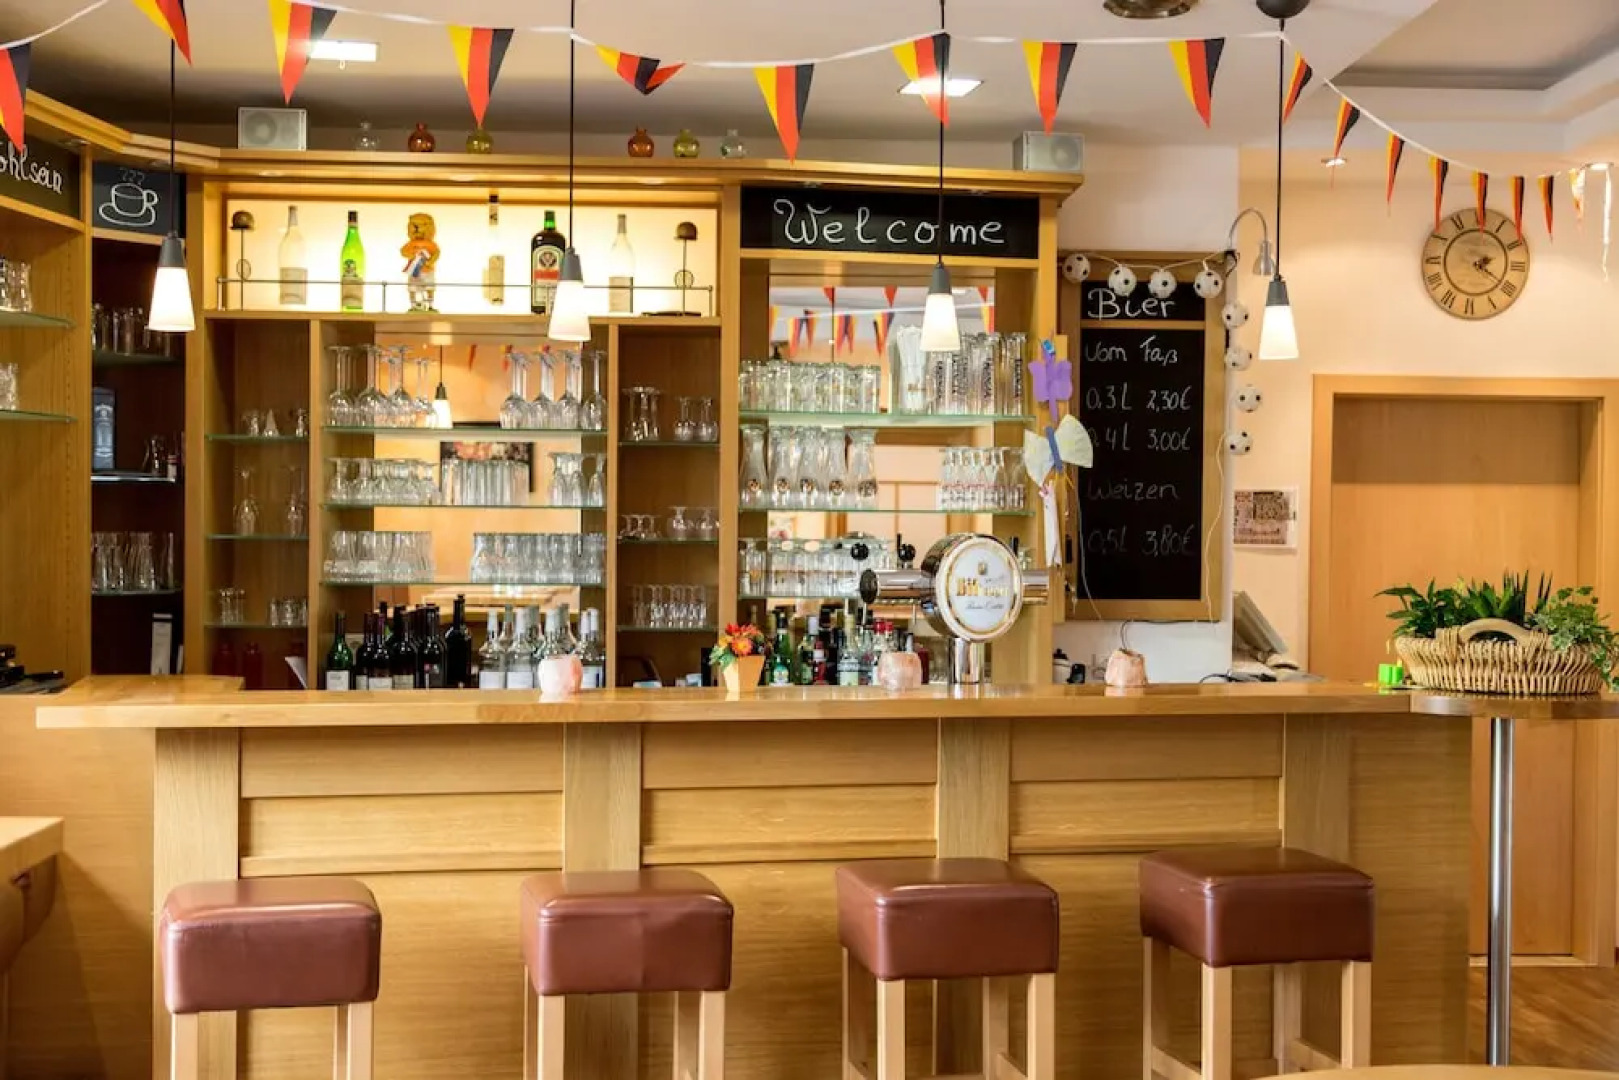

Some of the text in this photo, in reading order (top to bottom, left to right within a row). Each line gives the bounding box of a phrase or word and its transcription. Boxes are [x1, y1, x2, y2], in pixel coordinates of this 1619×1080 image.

[0, 141, 62, 195] ohlsein
[773, 199, 1005, 245] Welcome
[1087, 287, 1176, 321] Bier
[1088, 477, 1180, 501] Weizen
